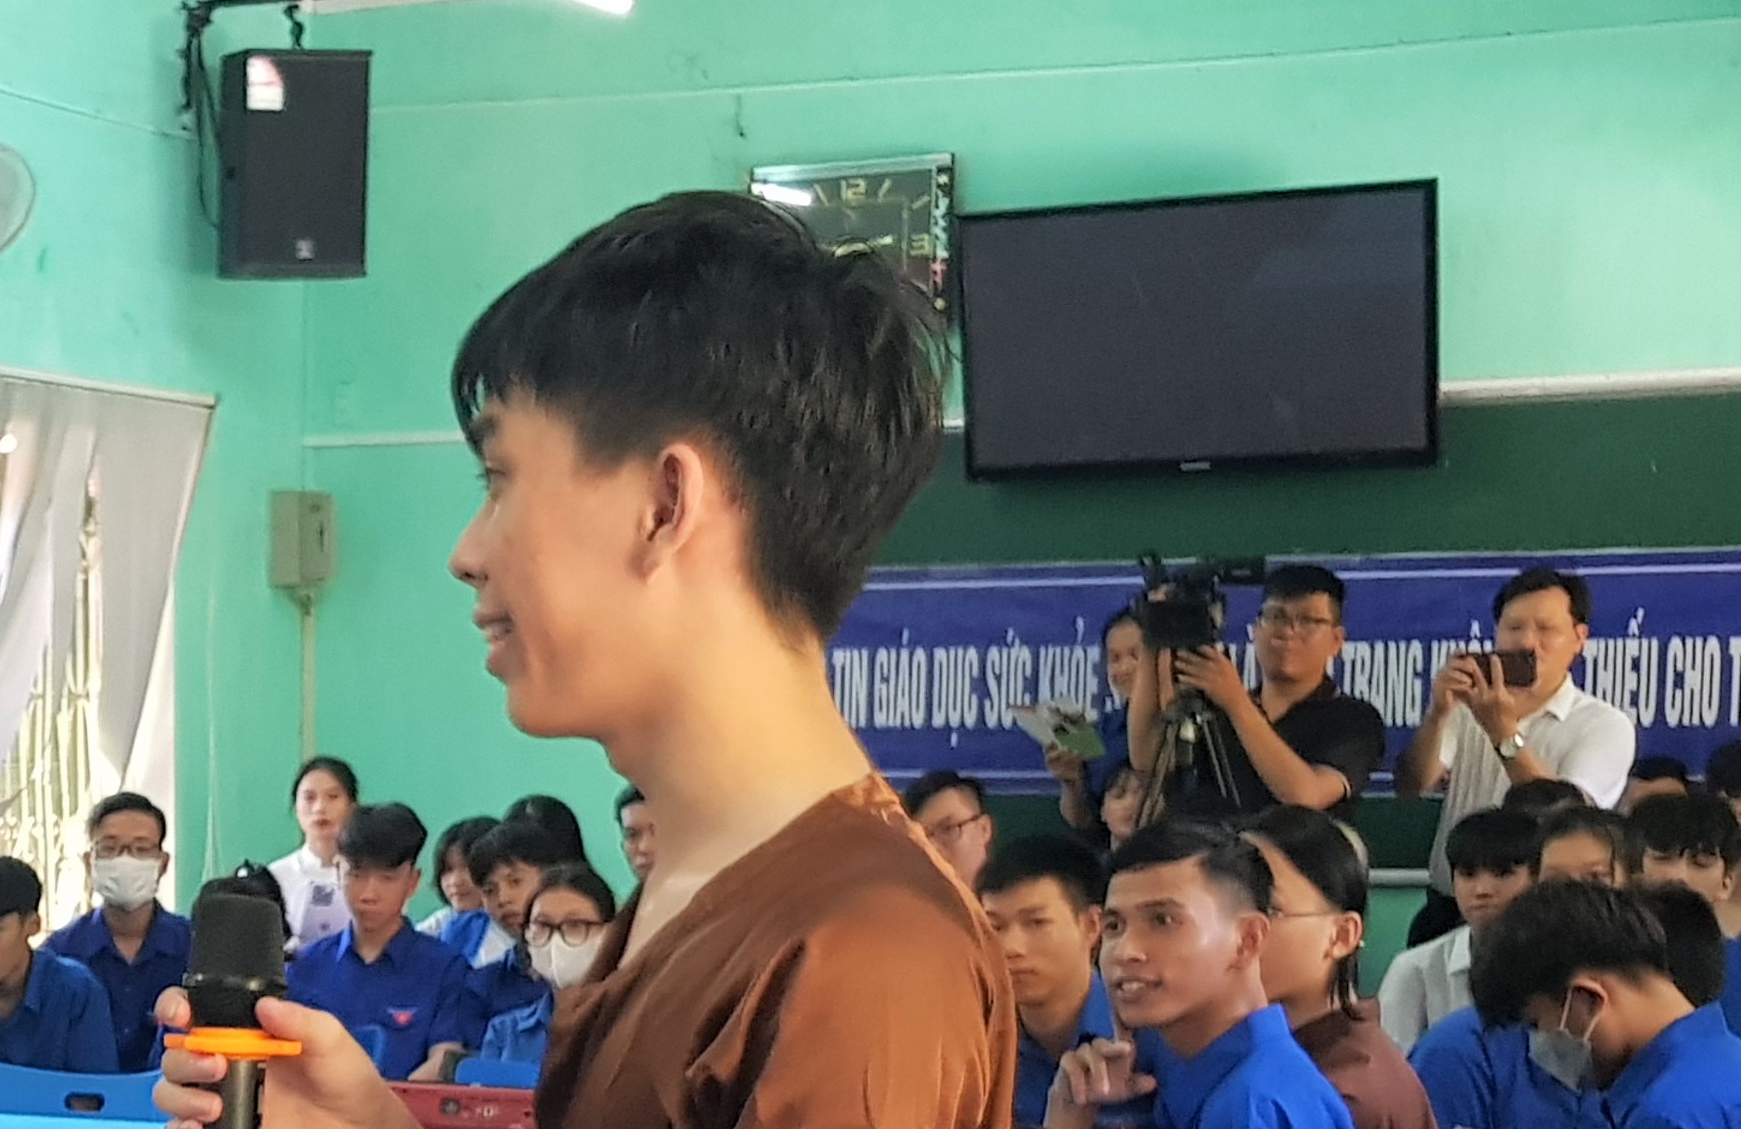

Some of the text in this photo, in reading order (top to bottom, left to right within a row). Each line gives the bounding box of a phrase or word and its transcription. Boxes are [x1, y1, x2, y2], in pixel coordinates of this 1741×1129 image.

[840, 178, 866, 202] 12
[832, 646, 869, 729] TIN
[873, 627, 927, 730] GIÁO
[931, 645, 979, 748] DỤC
[984, 627, 1032, 730] SỨC
[1037, 615, 1101, 723] KHỎE
[1341, 639, 1423, 727] TRANG
[1581, 607, 1658, 728] THIẾU
[1664, 635, 1721, 729] CHO
